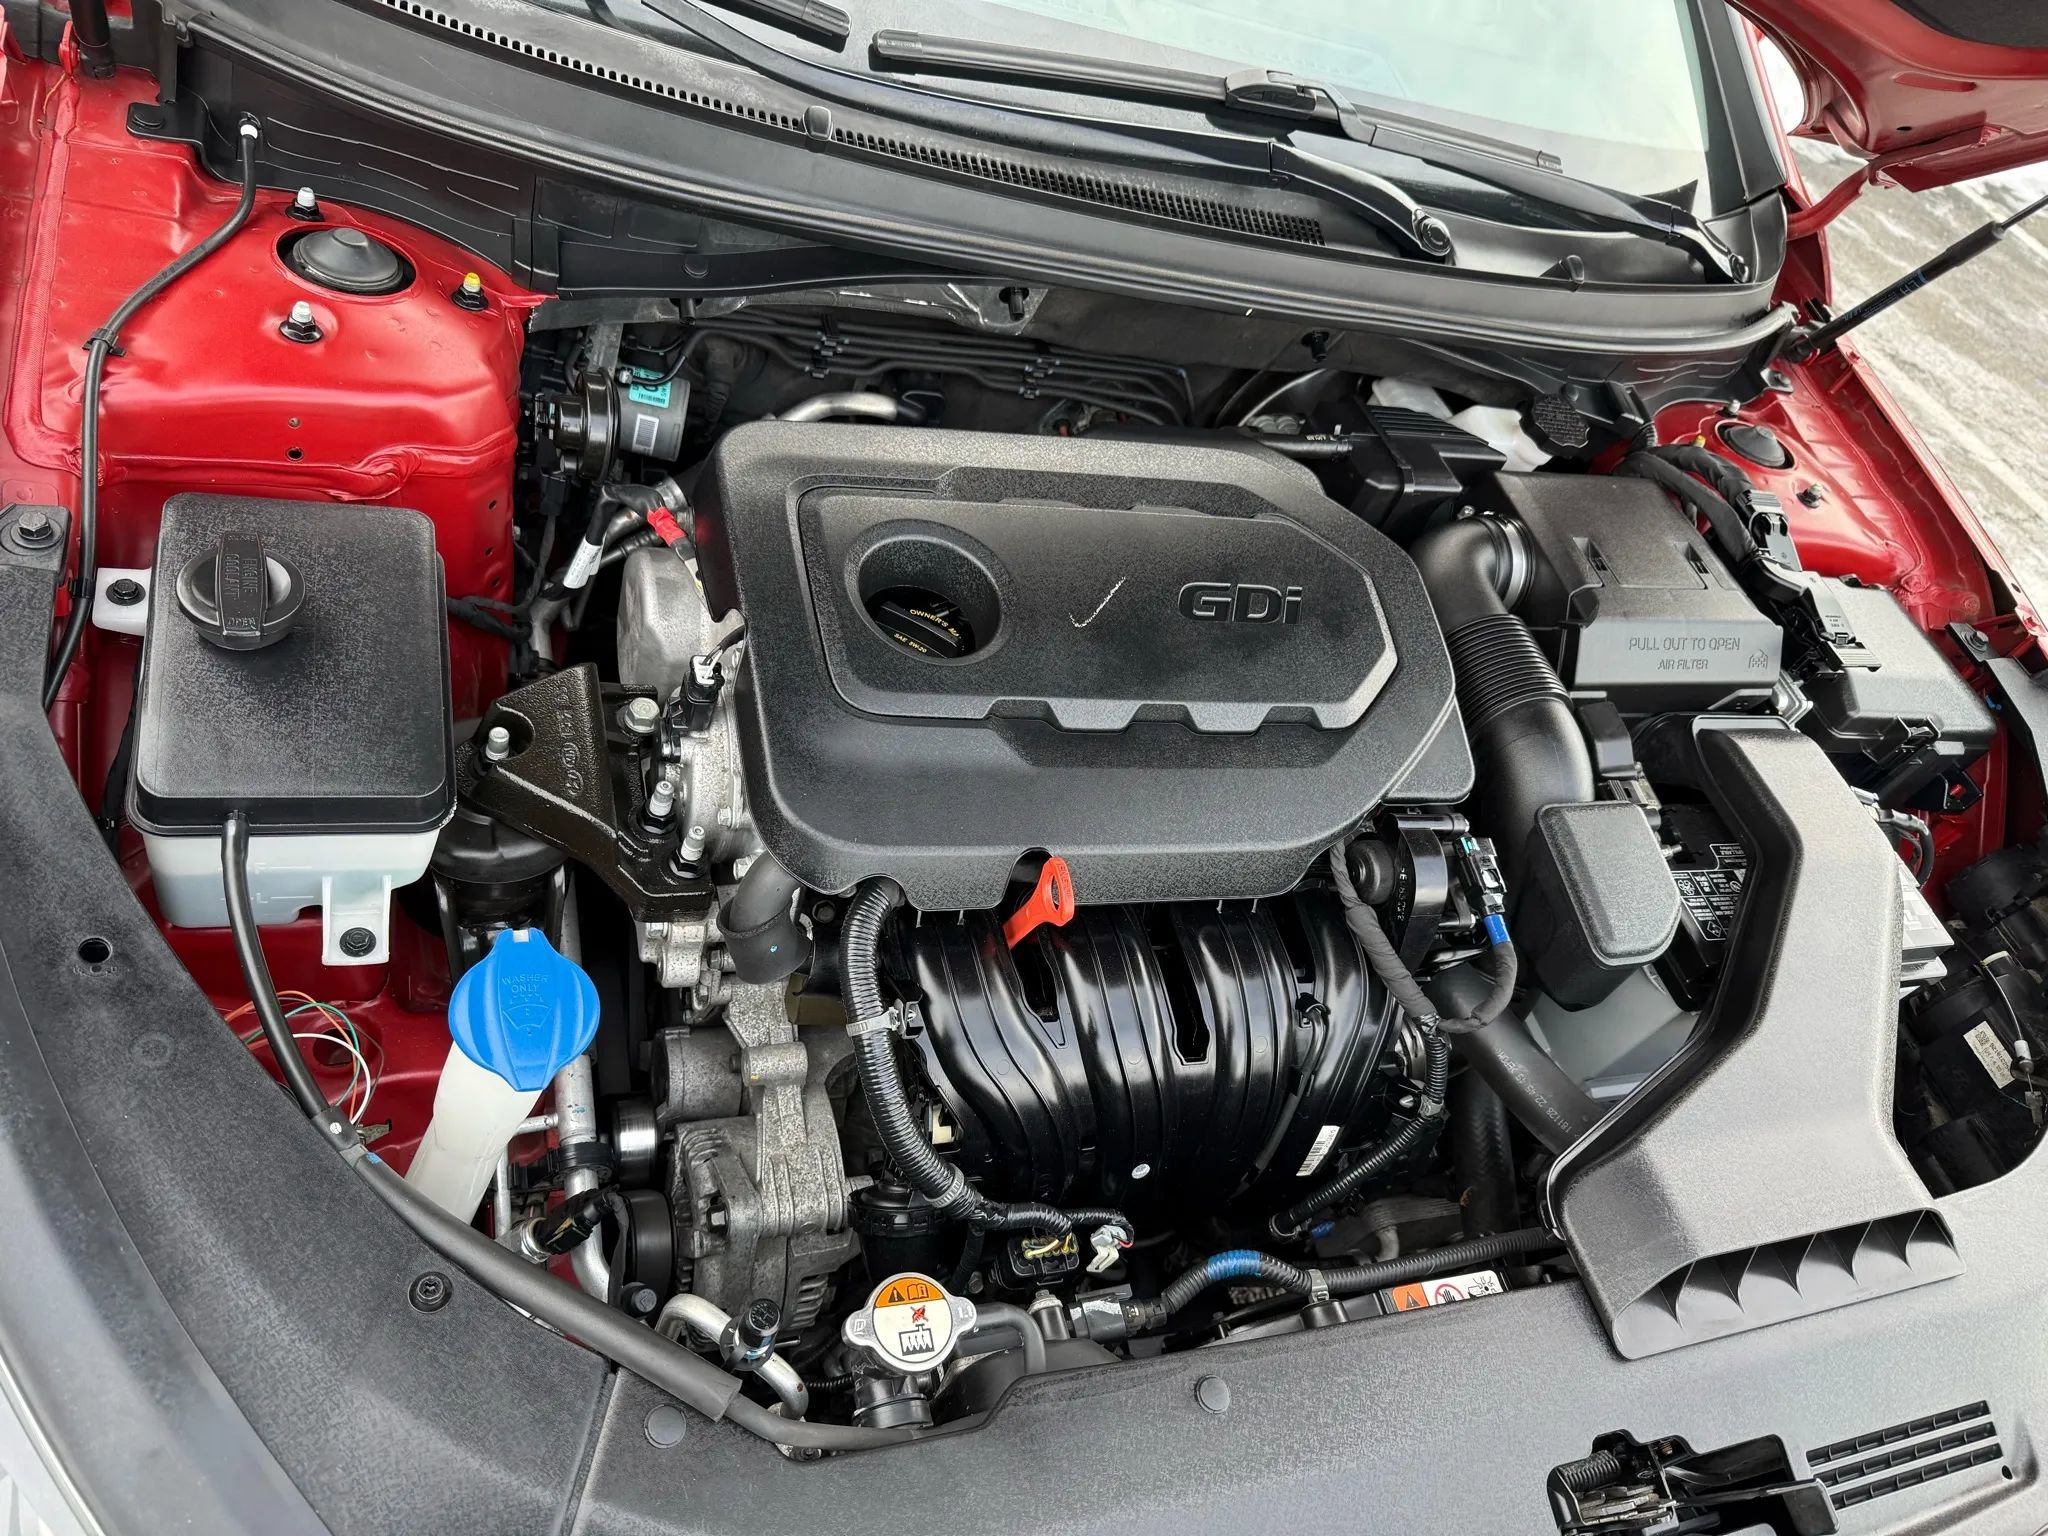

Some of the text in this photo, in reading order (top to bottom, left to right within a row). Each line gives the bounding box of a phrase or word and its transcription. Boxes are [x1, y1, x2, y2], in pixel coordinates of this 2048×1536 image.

[224, 553, 240, 600] COOLANT
[241, 558, 258, 594] ENGINE
[1178, 582, 1303, 624] GDi
[909, 608, 949, 628] OWNER'S
[1629, 637, 1741, 651] PULL OUT TO OPEN
[1657, 659, 1709, 670] AIR FILTER
[501, 973, 549, 985] WASHER
[511, 983, 538, 993] ONLY
